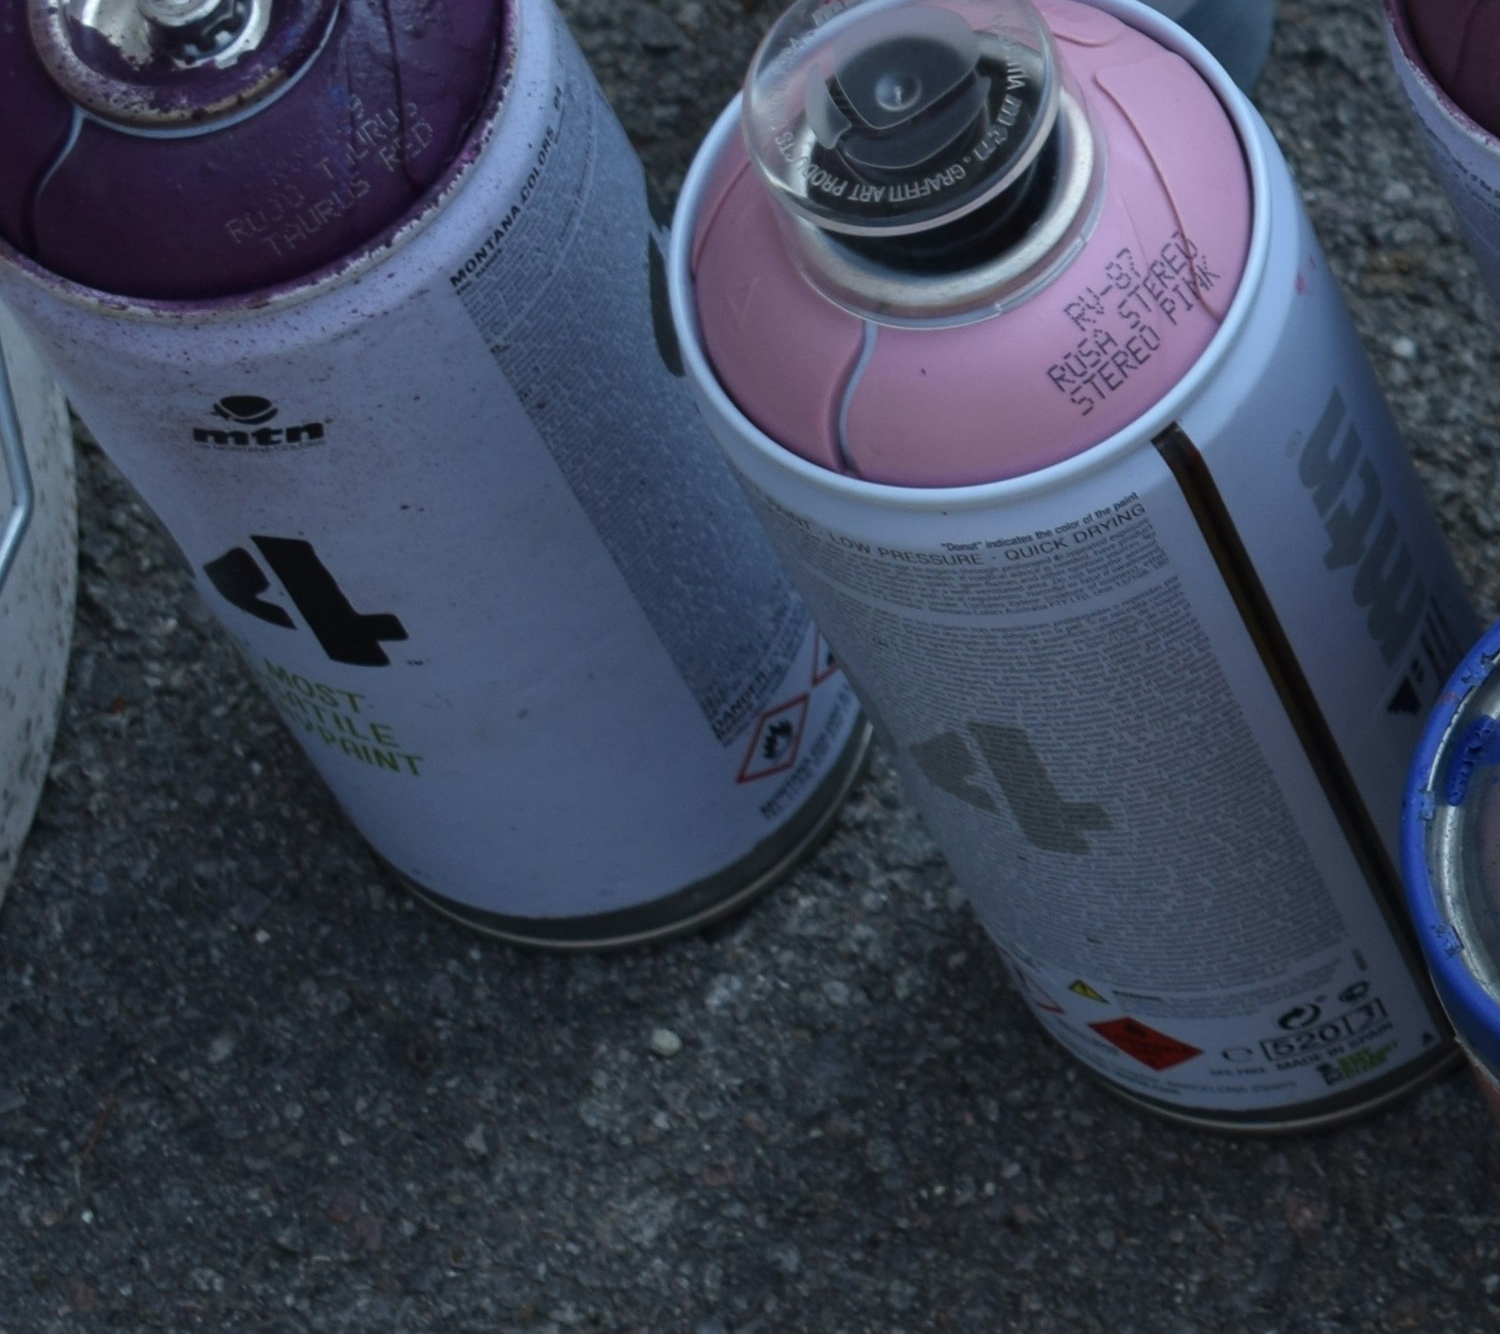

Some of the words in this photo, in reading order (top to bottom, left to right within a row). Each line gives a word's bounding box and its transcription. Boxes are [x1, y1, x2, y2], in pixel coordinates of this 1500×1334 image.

[846, 186, 884, 204] ART
[889, 164, 967, 204] GRAFFITI
[450, 204, 523, 289] MONTANA
[1158, 254, 1222, 327] PINK
[193, 421, 325, 447] mtn
[828, 532, 873, 555] LOW
[877, 545, 985, 566] PRESSURE
[1004, 536, 1070, 562] QUICK
[1072, 502, 1147, 545] DRYING
[263, 657, 366, 714] MOST
